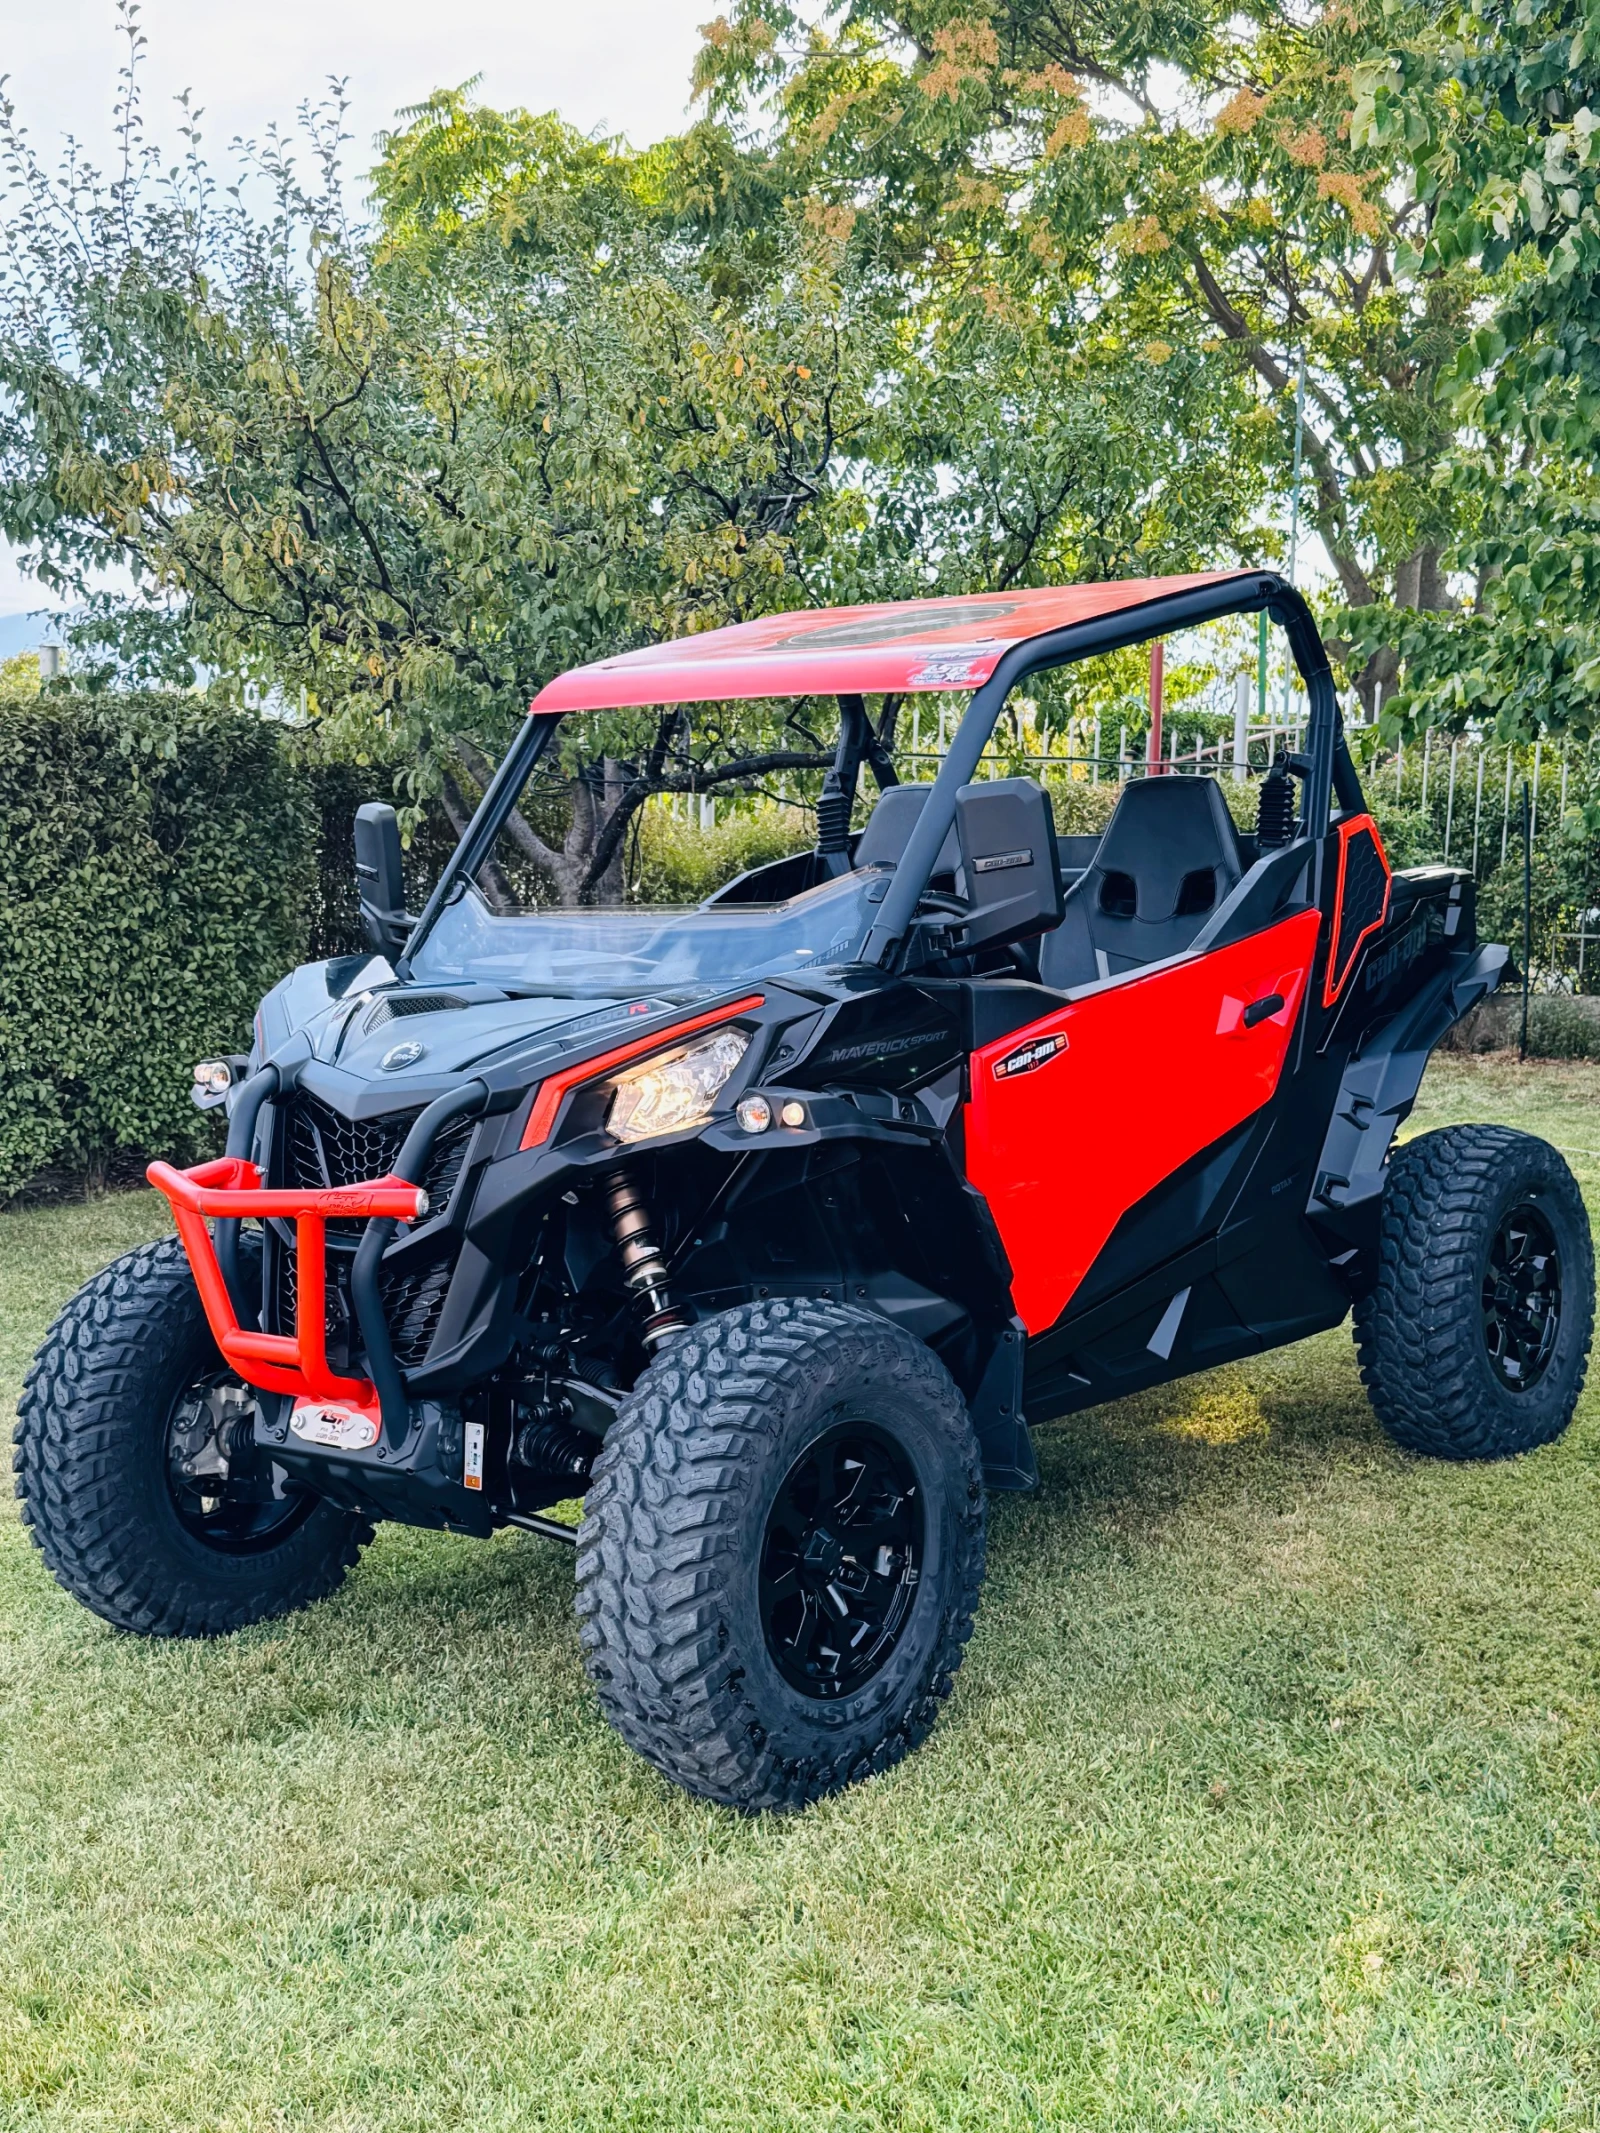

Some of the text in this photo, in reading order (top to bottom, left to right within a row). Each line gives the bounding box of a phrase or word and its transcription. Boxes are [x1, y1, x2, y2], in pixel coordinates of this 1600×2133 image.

[570, 1003, 650, 1035] 1000R
[831, 1031, 948, 1062] MAVERICK SPORT
[1007, 1041, 1055, 1073] can-am
